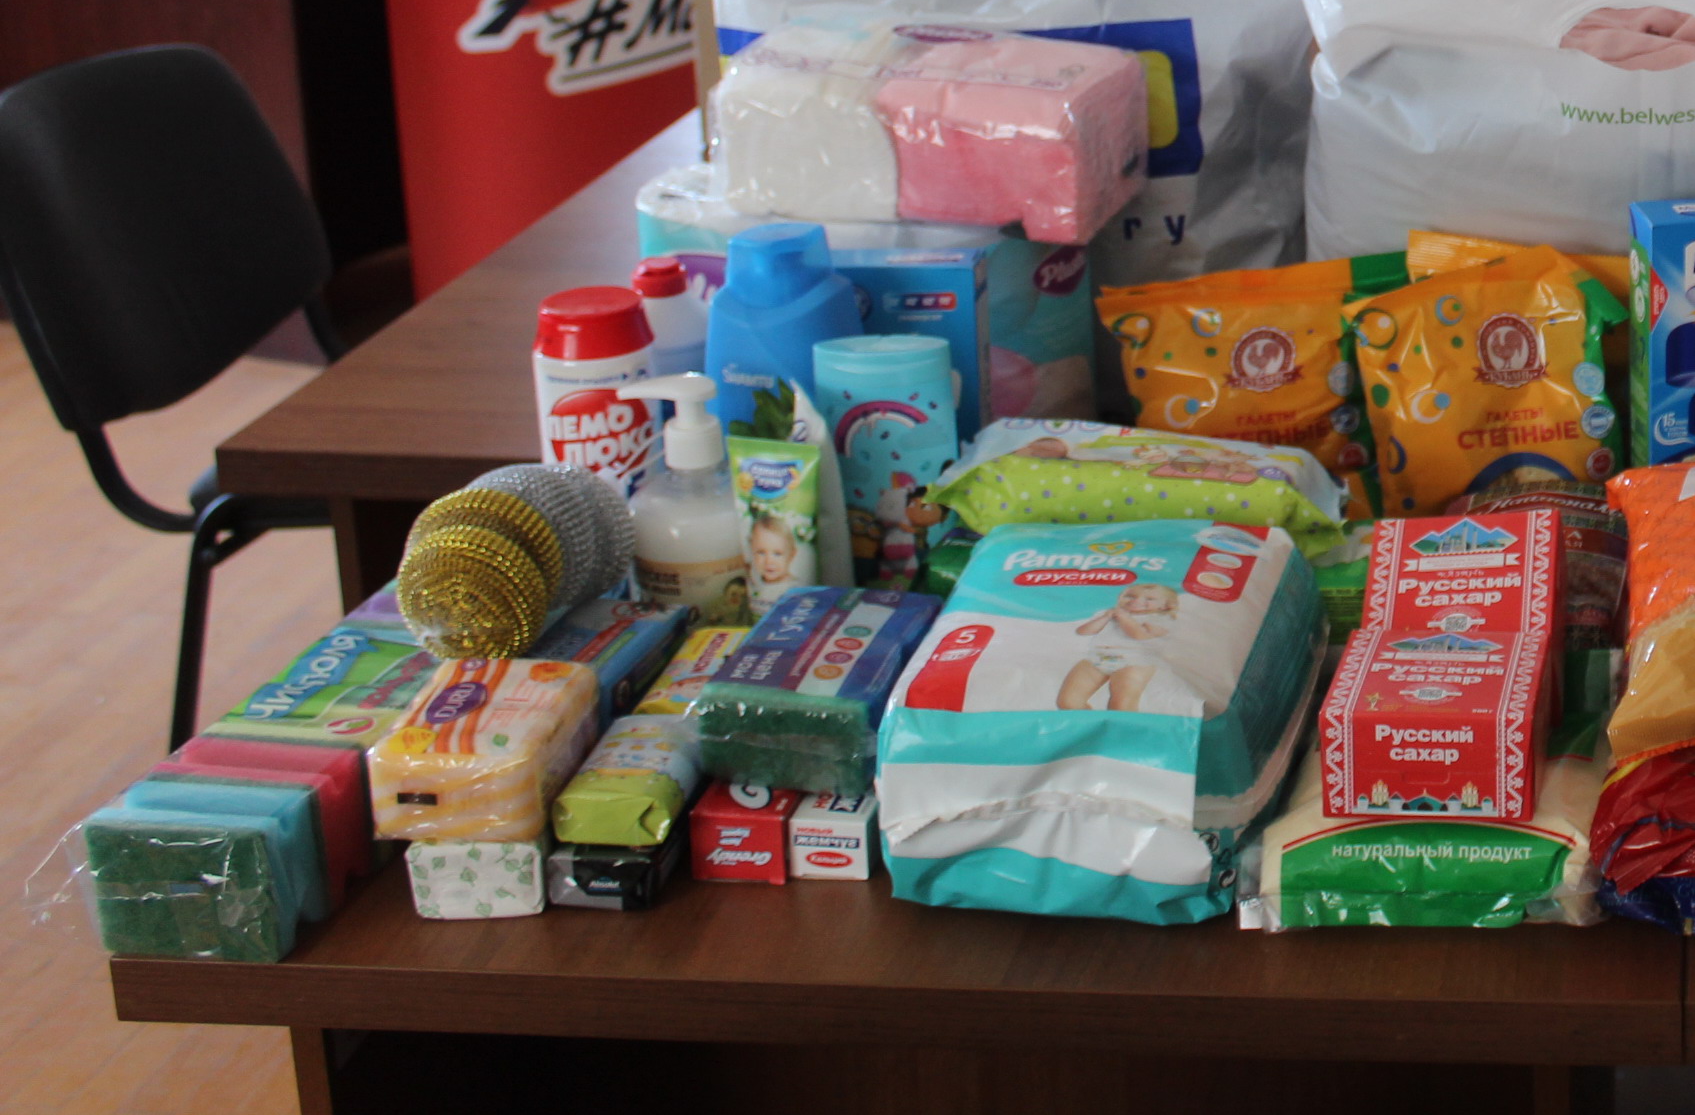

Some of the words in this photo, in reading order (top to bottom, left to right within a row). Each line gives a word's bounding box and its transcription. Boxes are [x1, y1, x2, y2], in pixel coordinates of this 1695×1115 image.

[1458, 421, 1580, 451] СТЕПНЫЕ
[1003, 548, 1167, 572] Pampers
[1023, 570, 1128, 583] трусики
[1398, 572, 1522, 594] Русский
[1415, 590, 1502, 607] сахар
[954, 629, 976, 645] 5
[1371, 662, 1504, 676] Русский
[1388, 673, 1482, 685] сахар
[434, 683, 477, 719] DURU
[1375, 723, 1474, 745] Русский
[1389, 747, 1460, 765] сахар
[1331, 843, 1453, 861] натуральный
[1458, 845, 1532, 864] продукт
